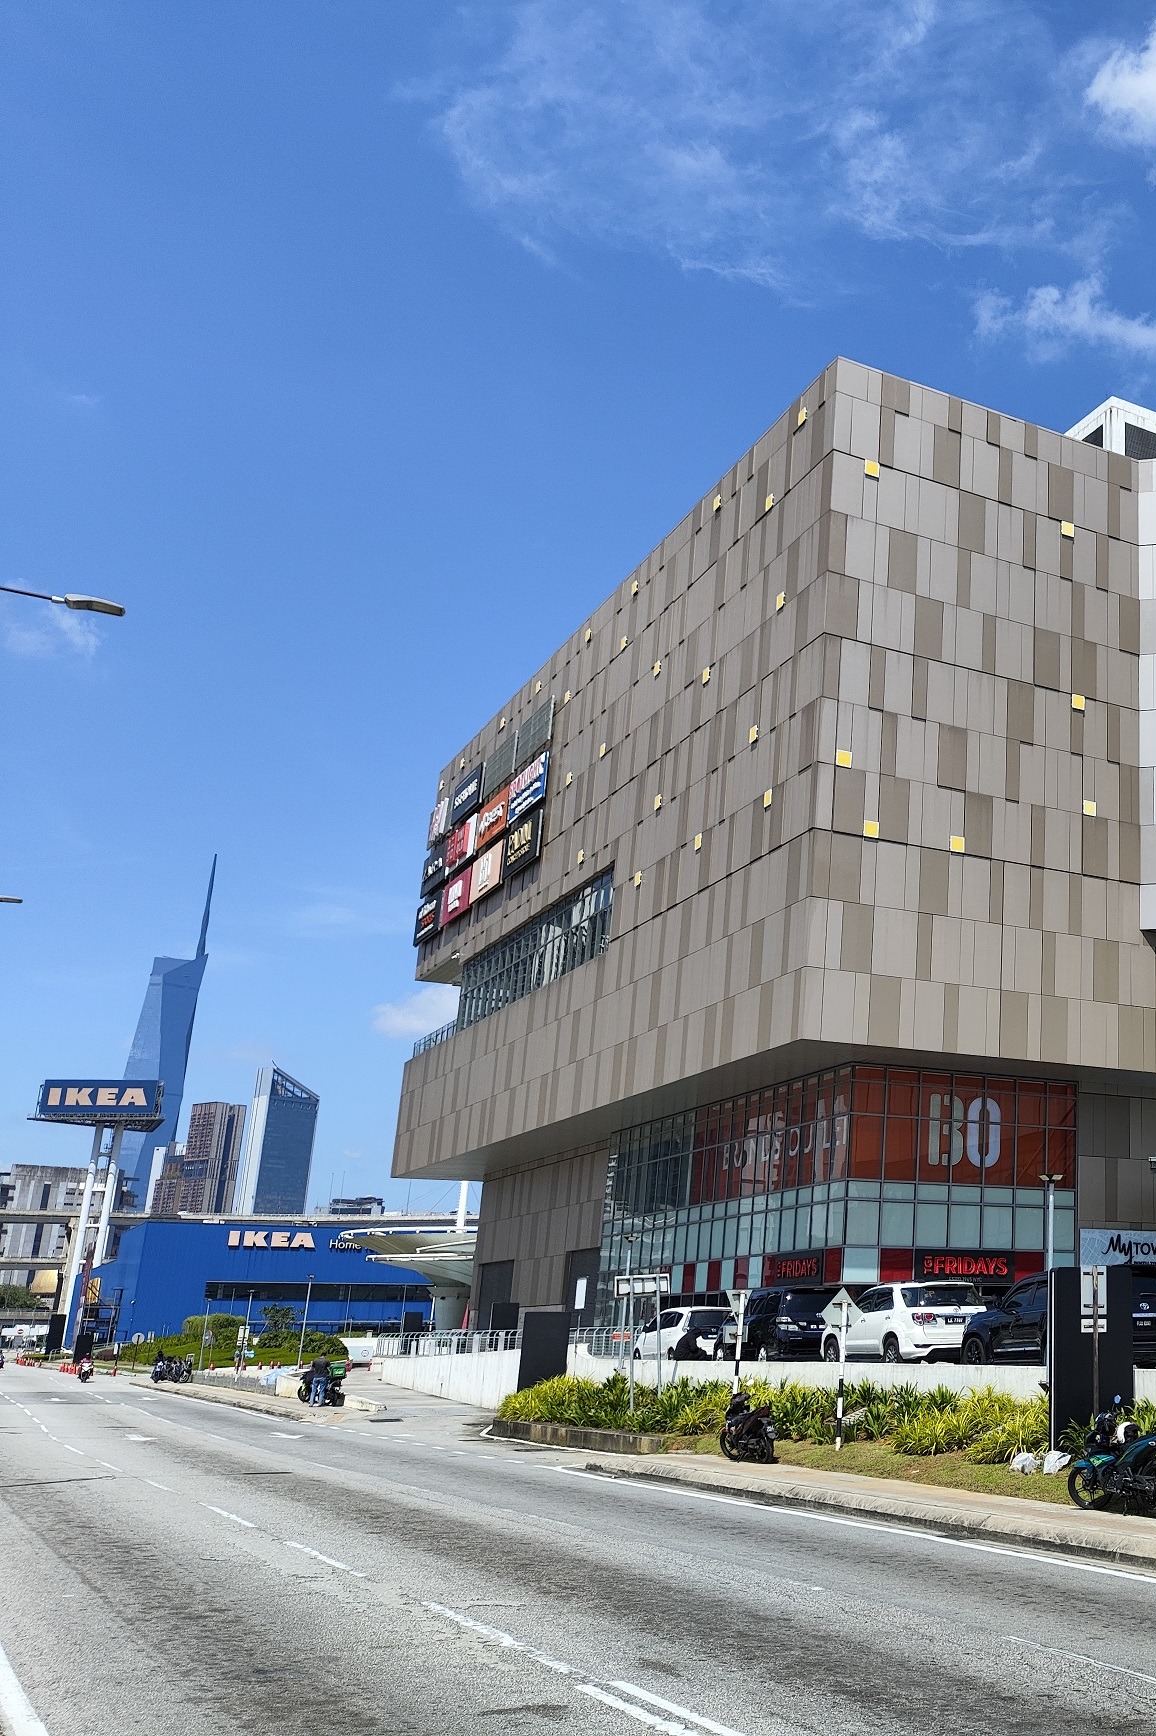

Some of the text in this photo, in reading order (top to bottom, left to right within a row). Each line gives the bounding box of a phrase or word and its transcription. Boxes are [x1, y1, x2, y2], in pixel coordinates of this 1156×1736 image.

[47, 1087, 147, 1106] IKEA
[228, 1230, 315, 1250] IKEA
[329, 1239, 361, 1250] Home
[782, 1257, 817, 1278] FRIDAYS
[933, 1256, 1009, 1275] FRIDAYS
